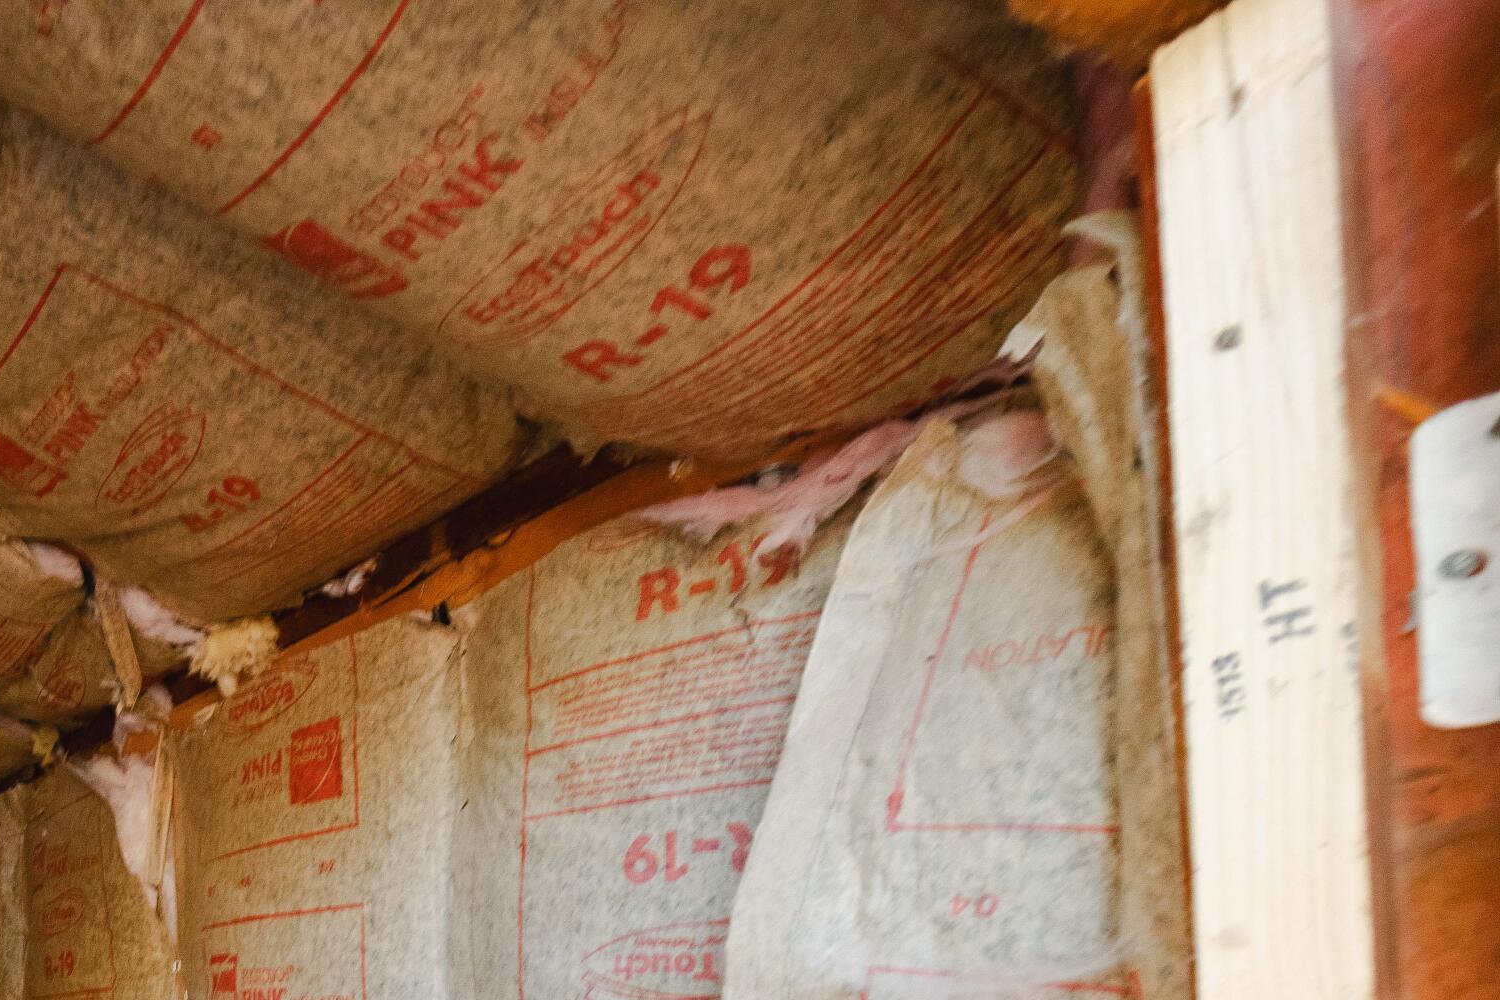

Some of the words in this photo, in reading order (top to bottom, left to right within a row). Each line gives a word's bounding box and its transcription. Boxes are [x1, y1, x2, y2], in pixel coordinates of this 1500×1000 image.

[380, 131, 525, 261] PINK
[464, 168, 662, 326] EcoTouch
[562, 243, 753, 382] R-19
[43, 401, 106, 457] PINK
[1257, 576, 1316, 645] HT
[612, 951, 722, 982] Touch
